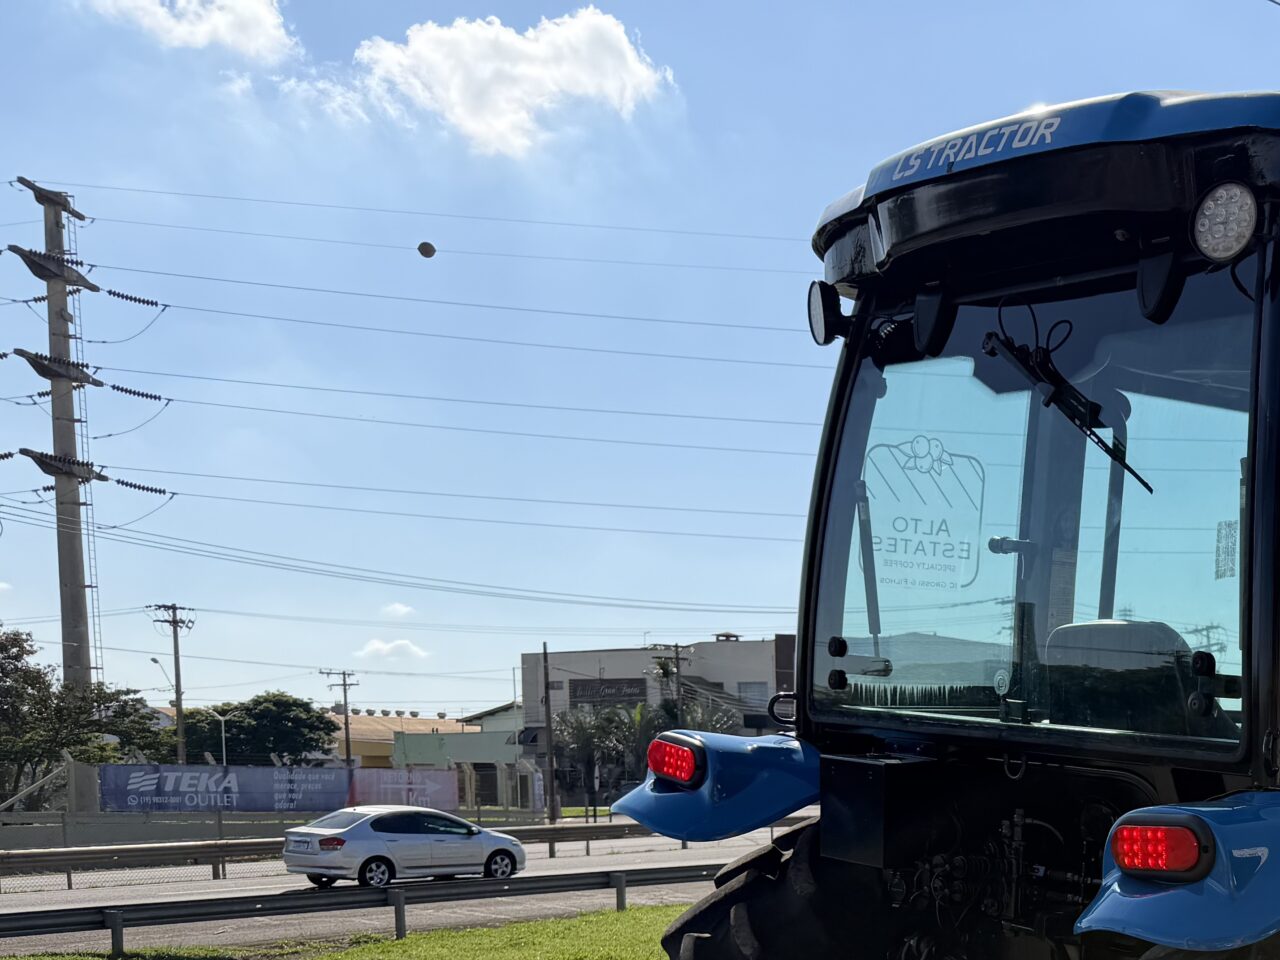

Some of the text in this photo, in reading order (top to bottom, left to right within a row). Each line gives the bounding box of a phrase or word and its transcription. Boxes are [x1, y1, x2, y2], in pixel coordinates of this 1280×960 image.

[892, 117, 1061, 181] LS TRACTOR
[163, 772, 239, 792] TEKA
[273, 771, 306, 780] Qualidade
[184, 793, 240, 806] OUTLET
